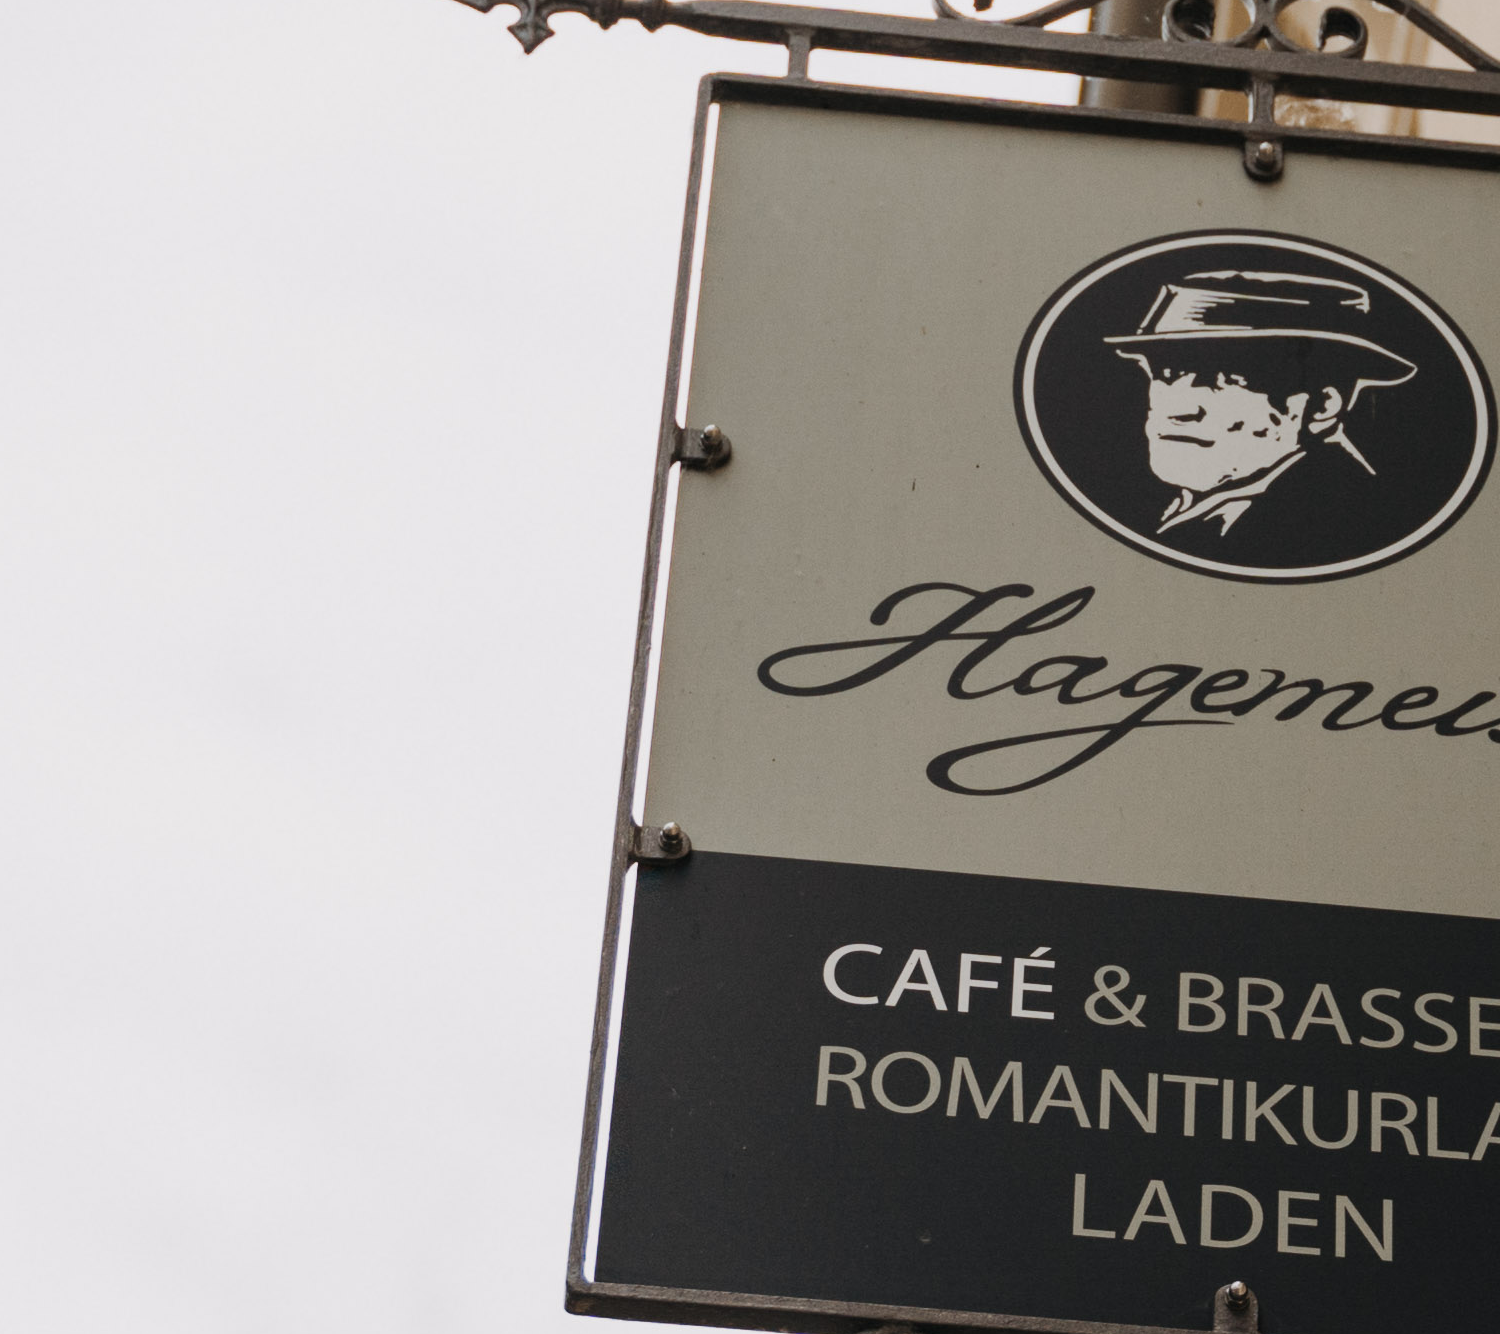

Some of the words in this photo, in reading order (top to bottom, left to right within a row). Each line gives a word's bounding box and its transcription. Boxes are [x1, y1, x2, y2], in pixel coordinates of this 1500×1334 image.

[821, 942, 1057, 1021] CAFÉ
[1083, 964, 1149, 1029] &
[1071, 1172, 1395, 1263] LADEN
